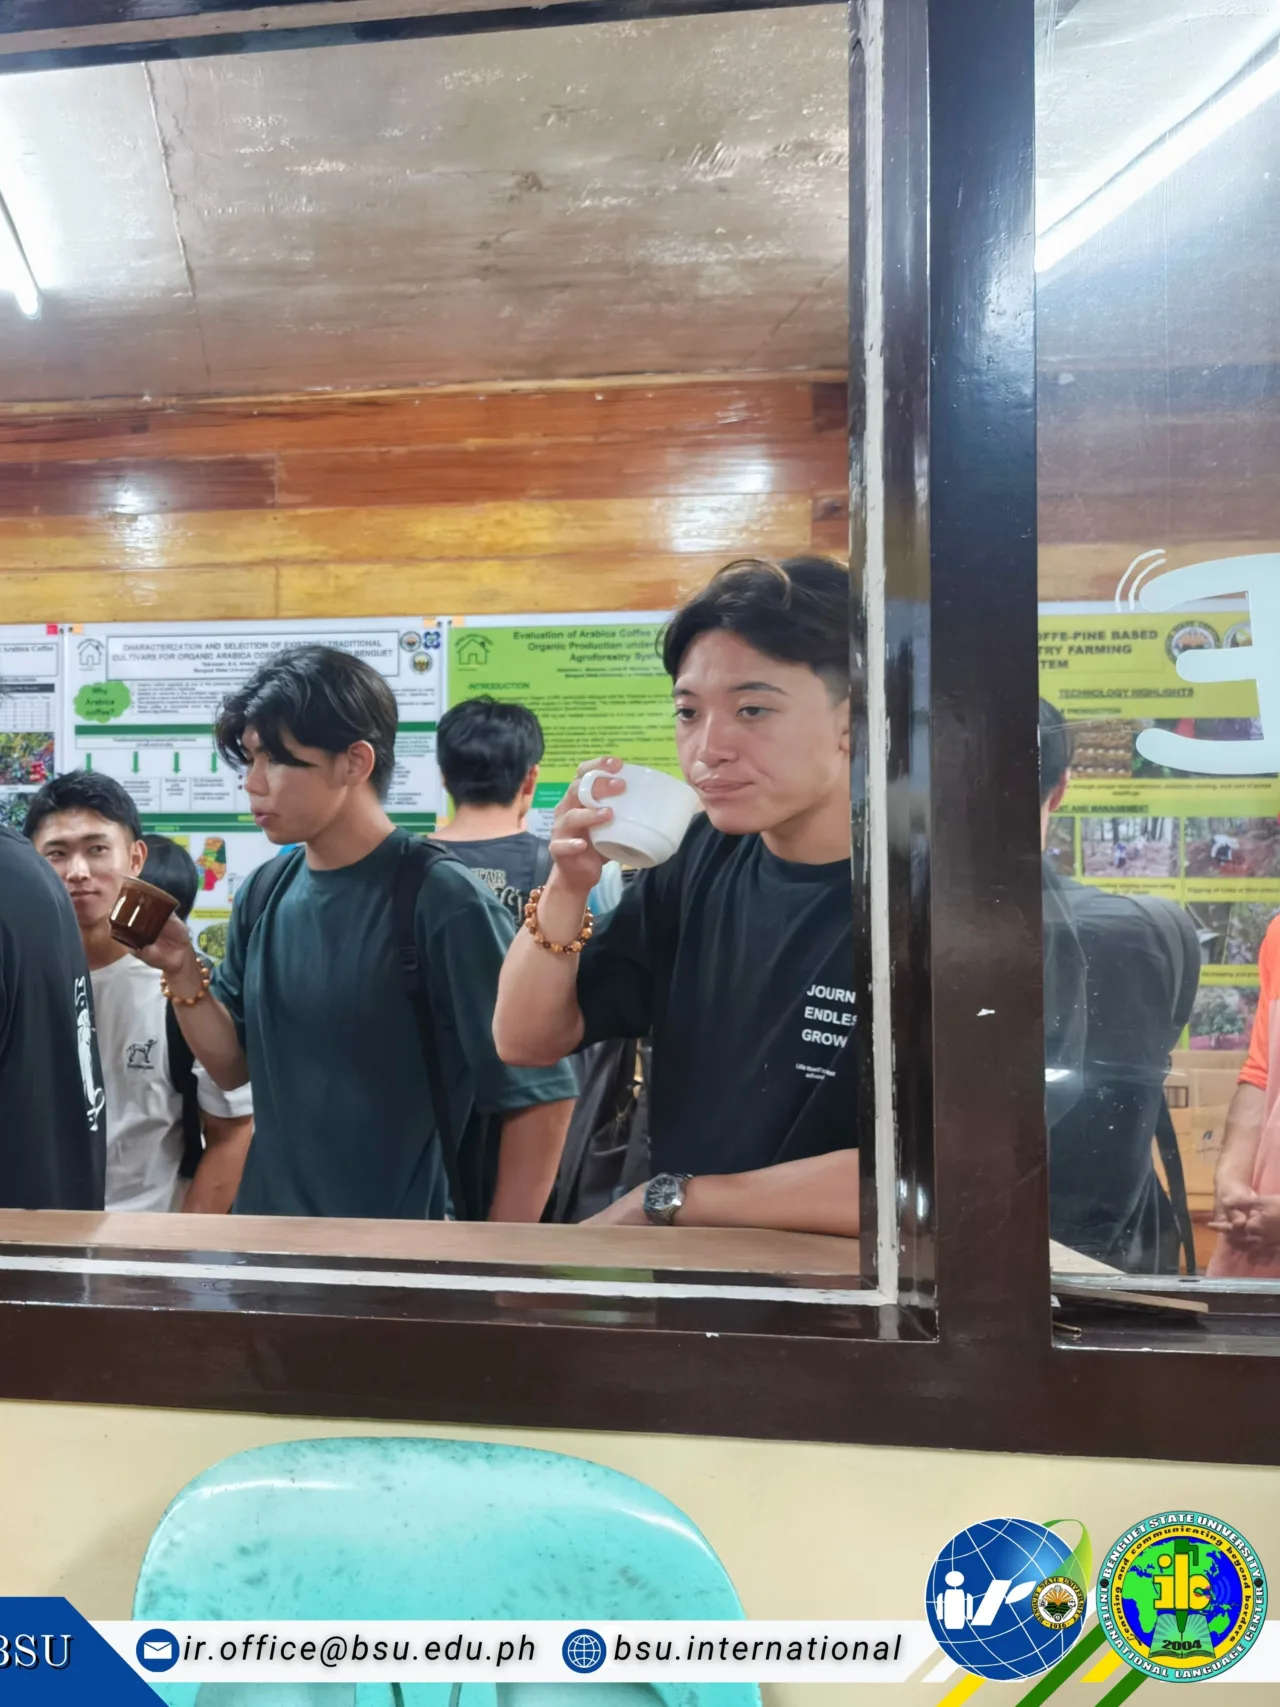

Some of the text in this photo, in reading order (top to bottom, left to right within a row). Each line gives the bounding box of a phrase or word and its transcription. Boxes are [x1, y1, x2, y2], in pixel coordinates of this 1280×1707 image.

[513, 631, 563, 641] Evaluation
[567, 631, 577, 640] of
[579, 630, 616, 640] Arabica
[1111, 630, 1158, 641] BASED
[123, 643, 203, 652] CHARACTERIZATION
[205, 642, 222, 651] AND
[224, 641, 269, 650] SELECTION
[271, 640, 282, 650] OF
[527, 642, 566, 652] Organic
[569, 641, 622, 650] Production
[1068, 644, 1132, 655] FARMING
[112, 653, 156, 662] CULTIVARS
[158, 652, 175, 661] FOR
[177, 651, 214, 661] ORGANIC
[216, 651, 251, 660] ARABICA
[354, 650, 392, 658] BENGUET
[570, 653, 631, 664] Agroforestry
[468, 682, 530, 691] INTRODUCTION
[1058, 688, 1129, 699] TECHNOLOGY
[84, 698, 115, 706] Arabica
[806, 984, 856, 1004] JOURN
[801, 1029, 848, 1048] GROW
